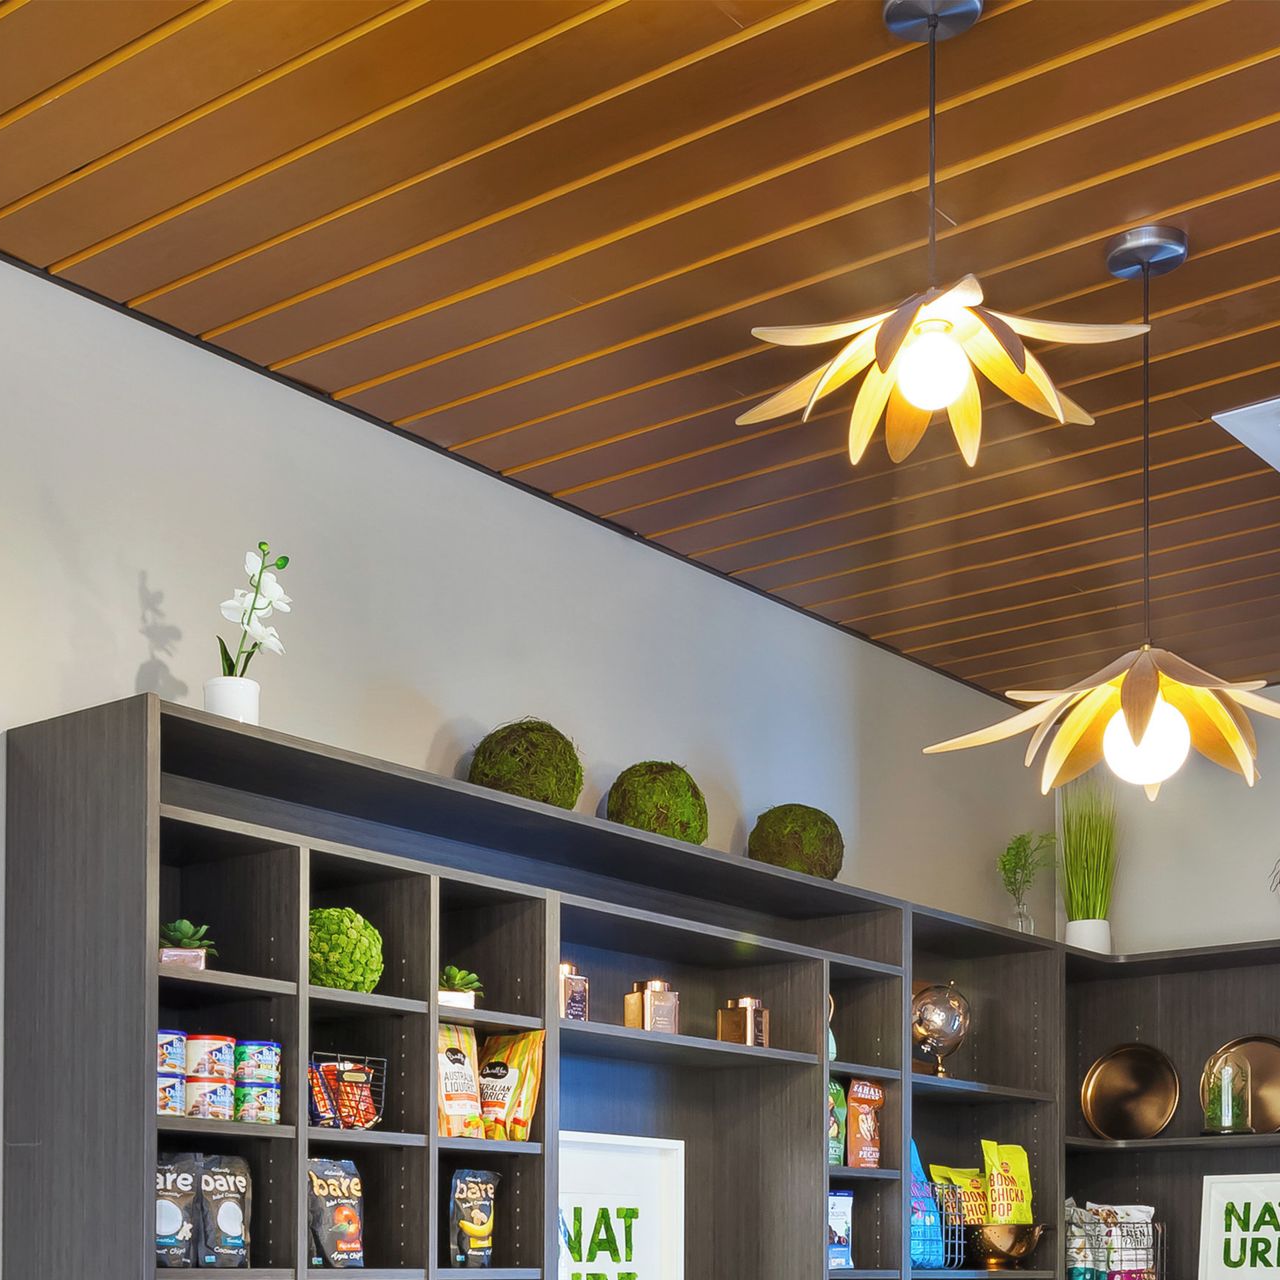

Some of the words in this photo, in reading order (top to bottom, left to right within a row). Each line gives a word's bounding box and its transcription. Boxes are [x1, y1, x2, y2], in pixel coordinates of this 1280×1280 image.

[156, 1173, 194, 1192] are
[308, 1170, 362, 1198] bare
[455, 1178, 494, 1199] bare
[989, 1173, 1018, 1188] BOOM
[990, 1189, 1024, 1203] CHICKA
[991, 1202, 1012, 1218] POP
